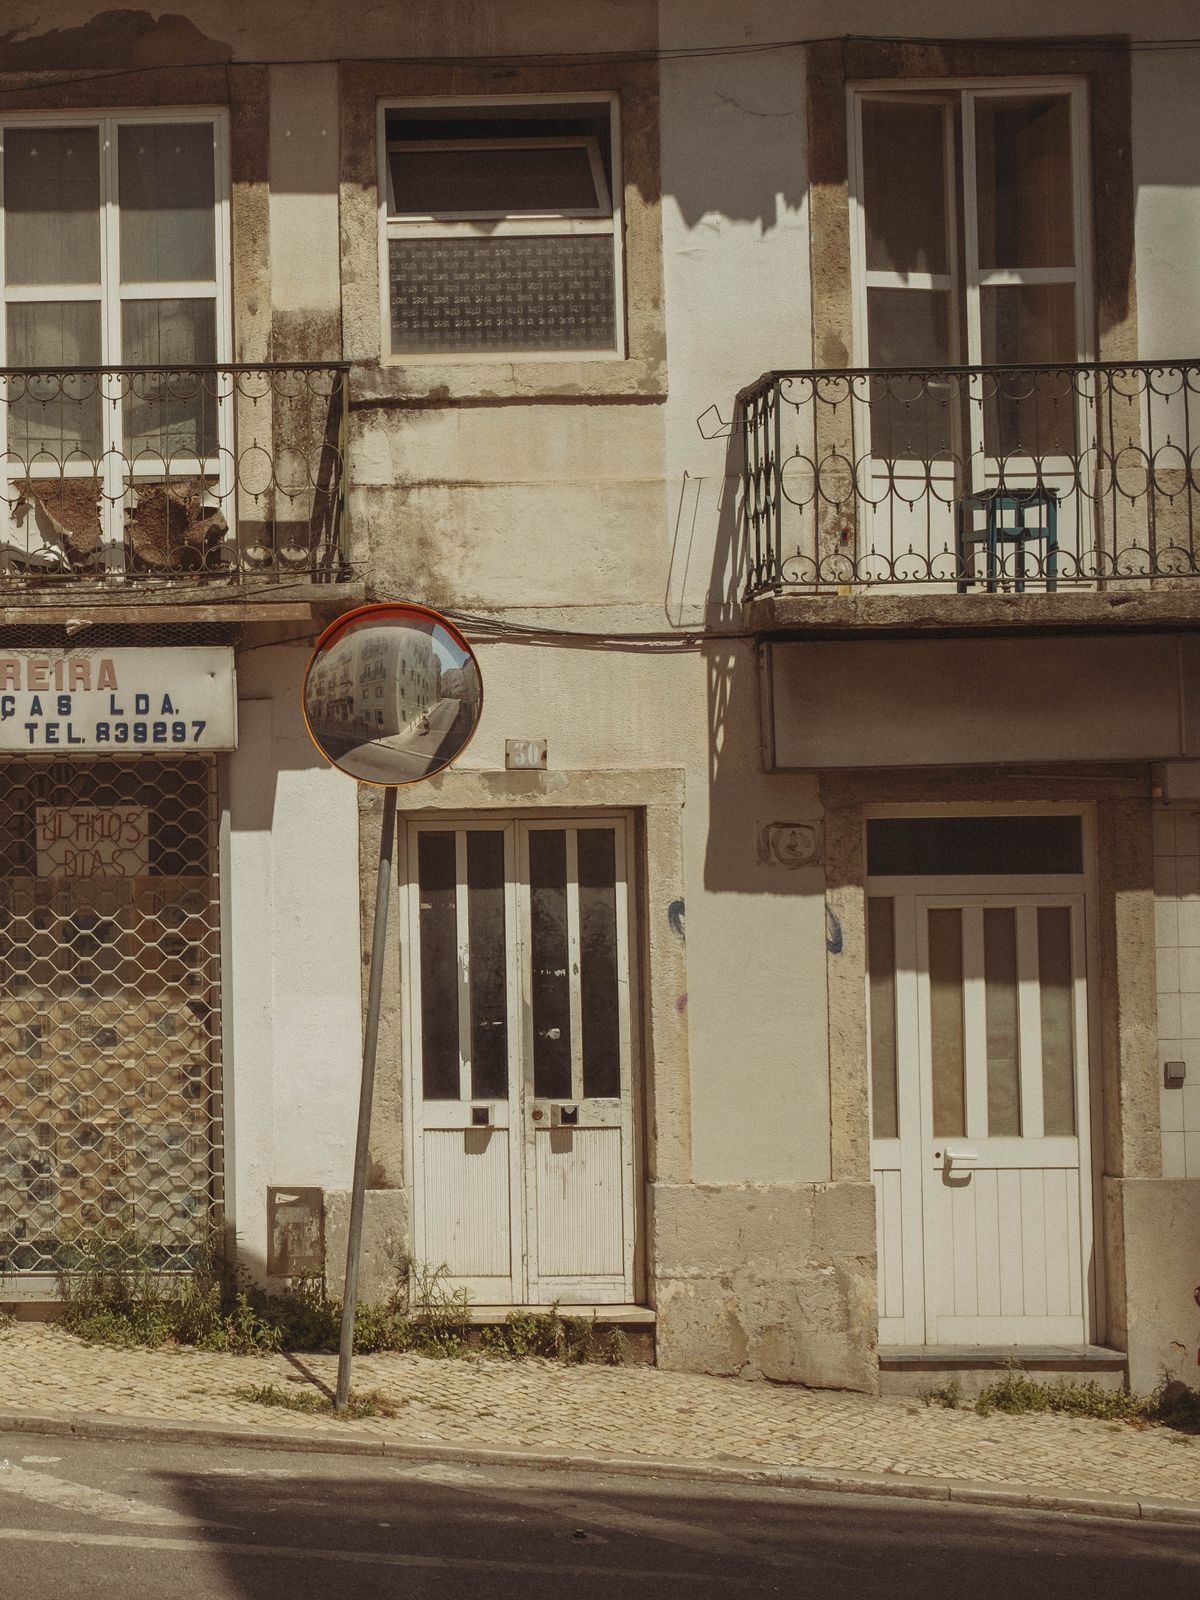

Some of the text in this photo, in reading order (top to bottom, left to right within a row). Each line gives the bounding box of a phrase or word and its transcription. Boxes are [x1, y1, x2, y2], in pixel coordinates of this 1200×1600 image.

[110, 693, 180, 715] LDA.
[24, 722, 86, 744] TEL.
[95, 721, 206, 744] 839297
[513, 742, 539, 766] 30
[64, 849, 127, 878] DIAS
